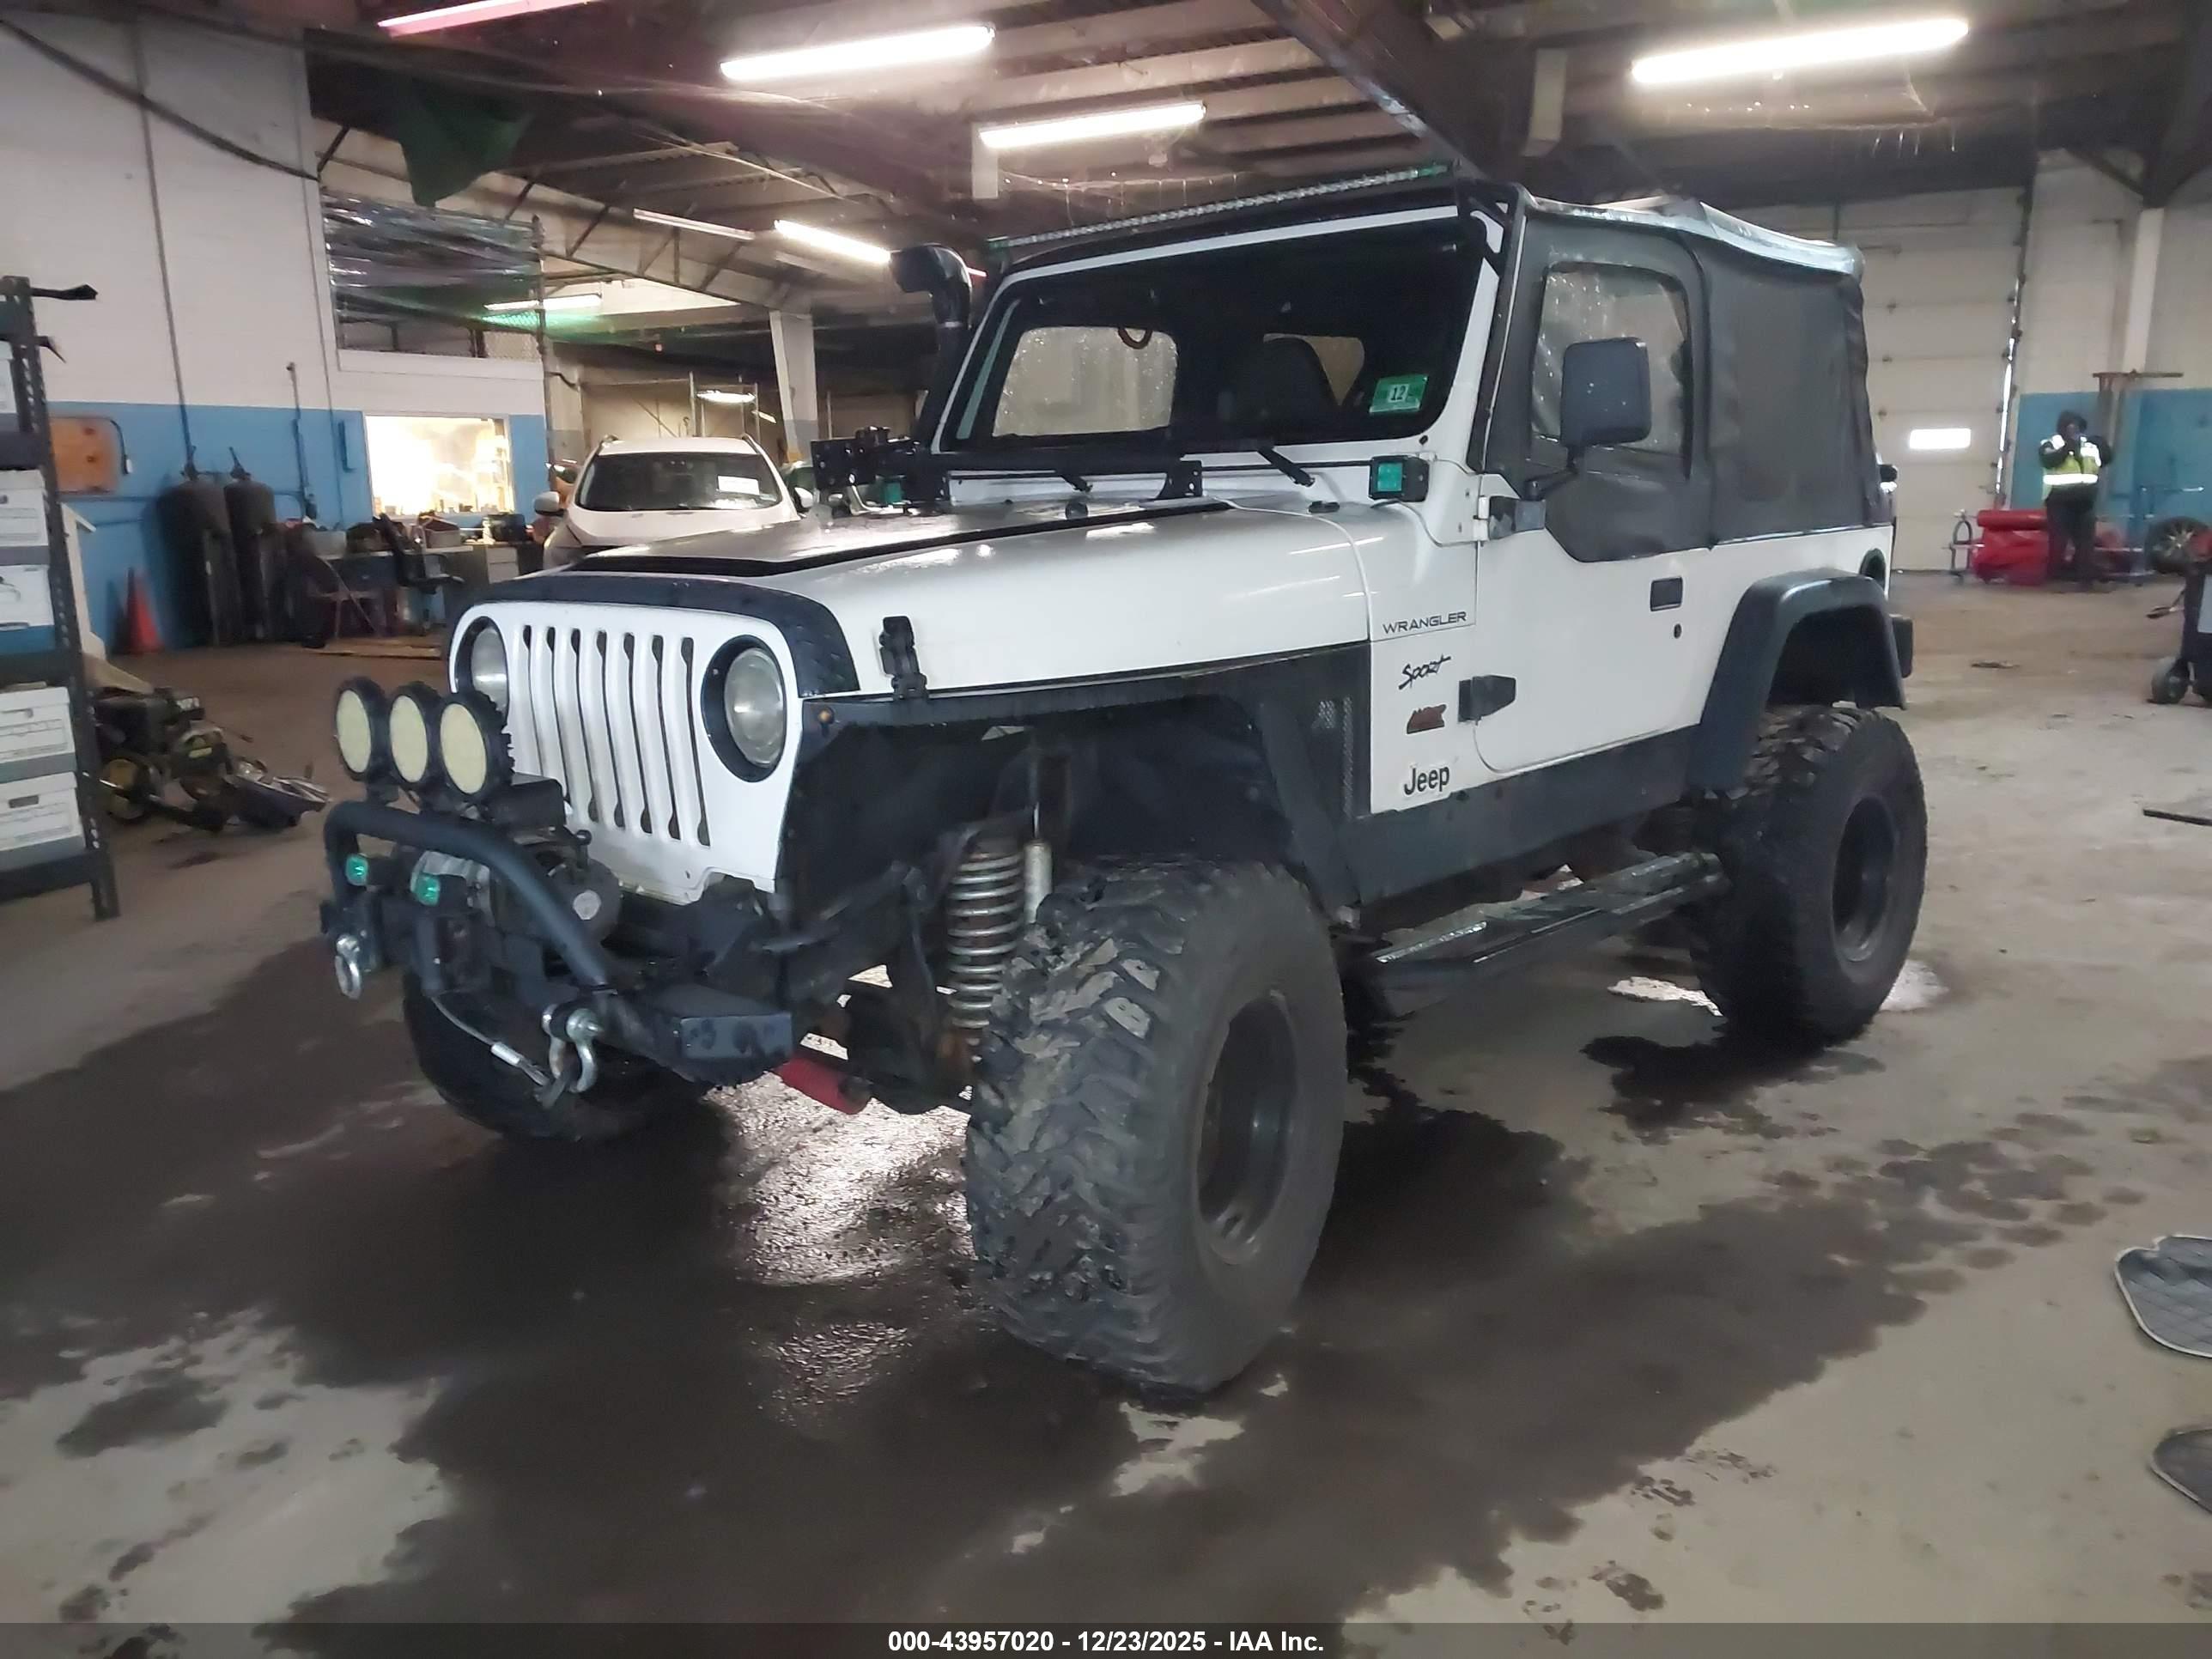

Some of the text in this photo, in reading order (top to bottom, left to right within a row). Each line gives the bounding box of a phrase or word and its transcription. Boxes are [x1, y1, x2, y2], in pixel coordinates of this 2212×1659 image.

[1390, 385, 1407, 401] 12
[1382, 611, 1468, 634] WRANGLER
[1404, 766, 1450, 795] Jeep
